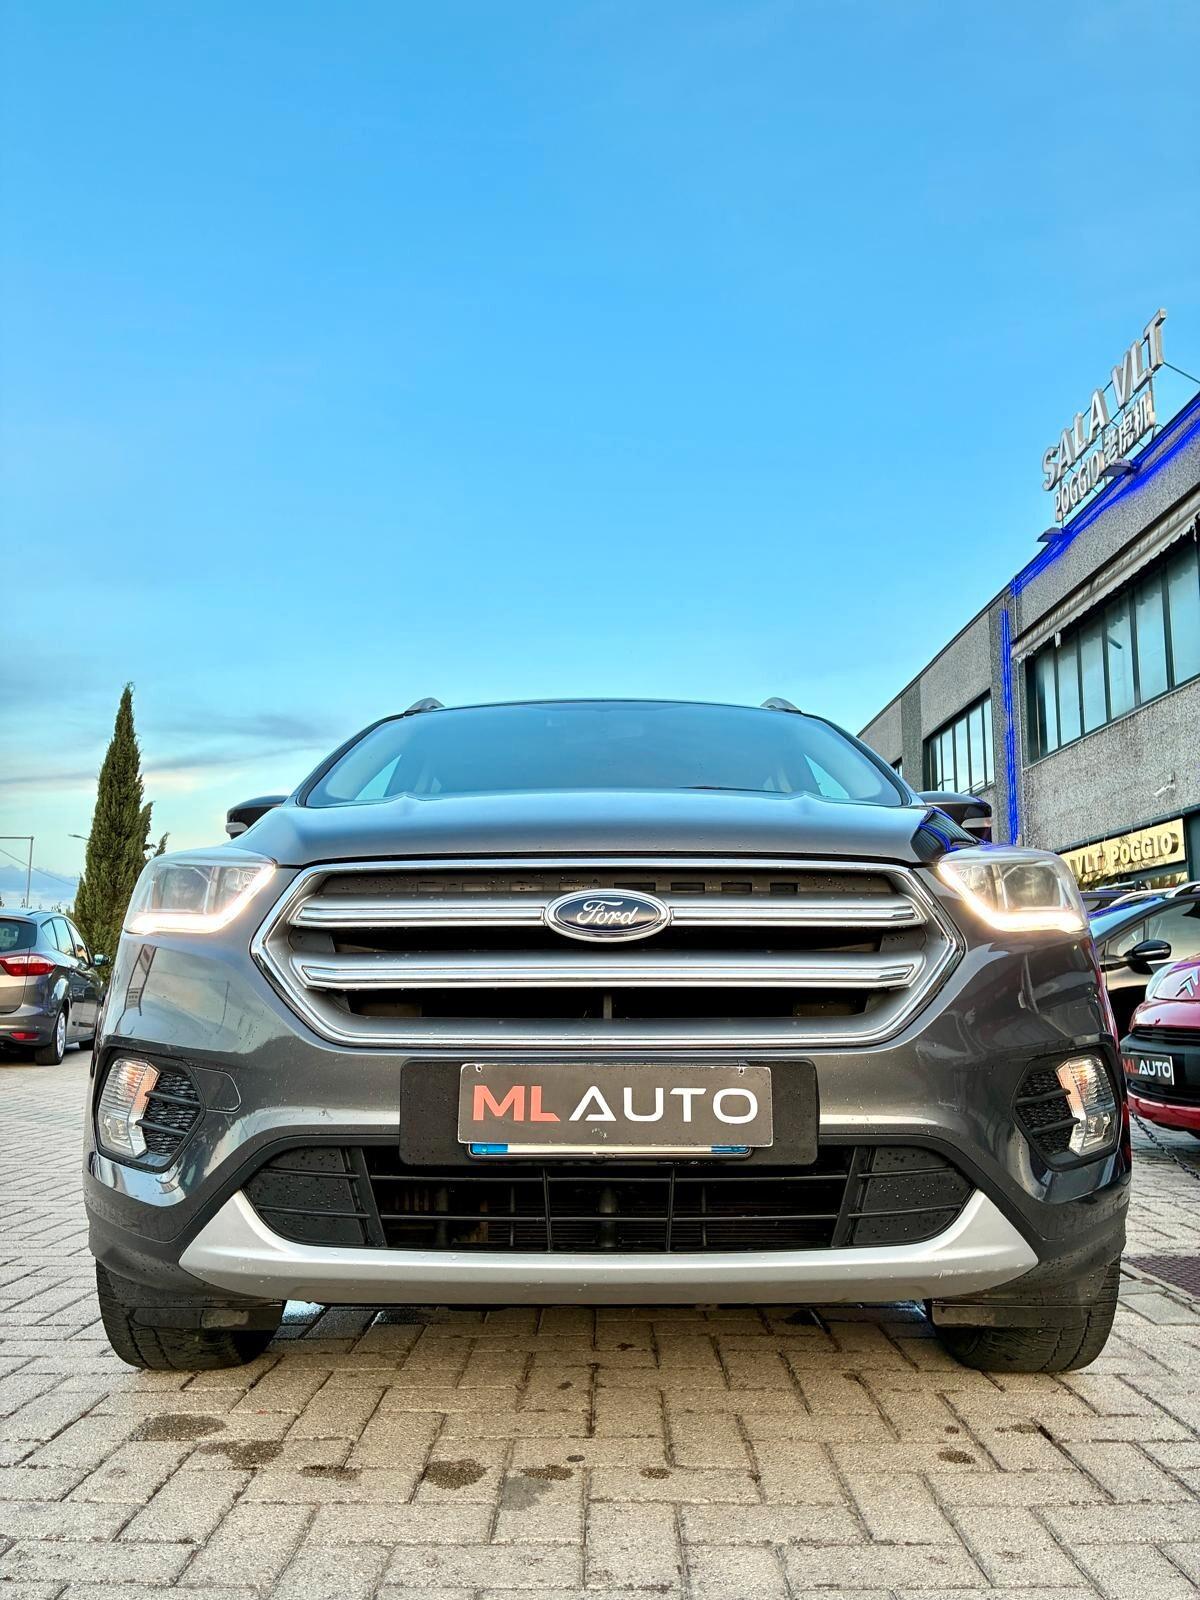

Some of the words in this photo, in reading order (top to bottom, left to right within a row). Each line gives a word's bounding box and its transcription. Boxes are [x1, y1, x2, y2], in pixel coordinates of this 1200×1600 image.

[1042, 388, 1110, 491] SALA
[1112, 308, 1167, 408] VLT
[1055, 449, 1105, 522] POGGIO
[1109, 832, 1179, 868] POGGIO
[576, 900, 639, 925] Ford
